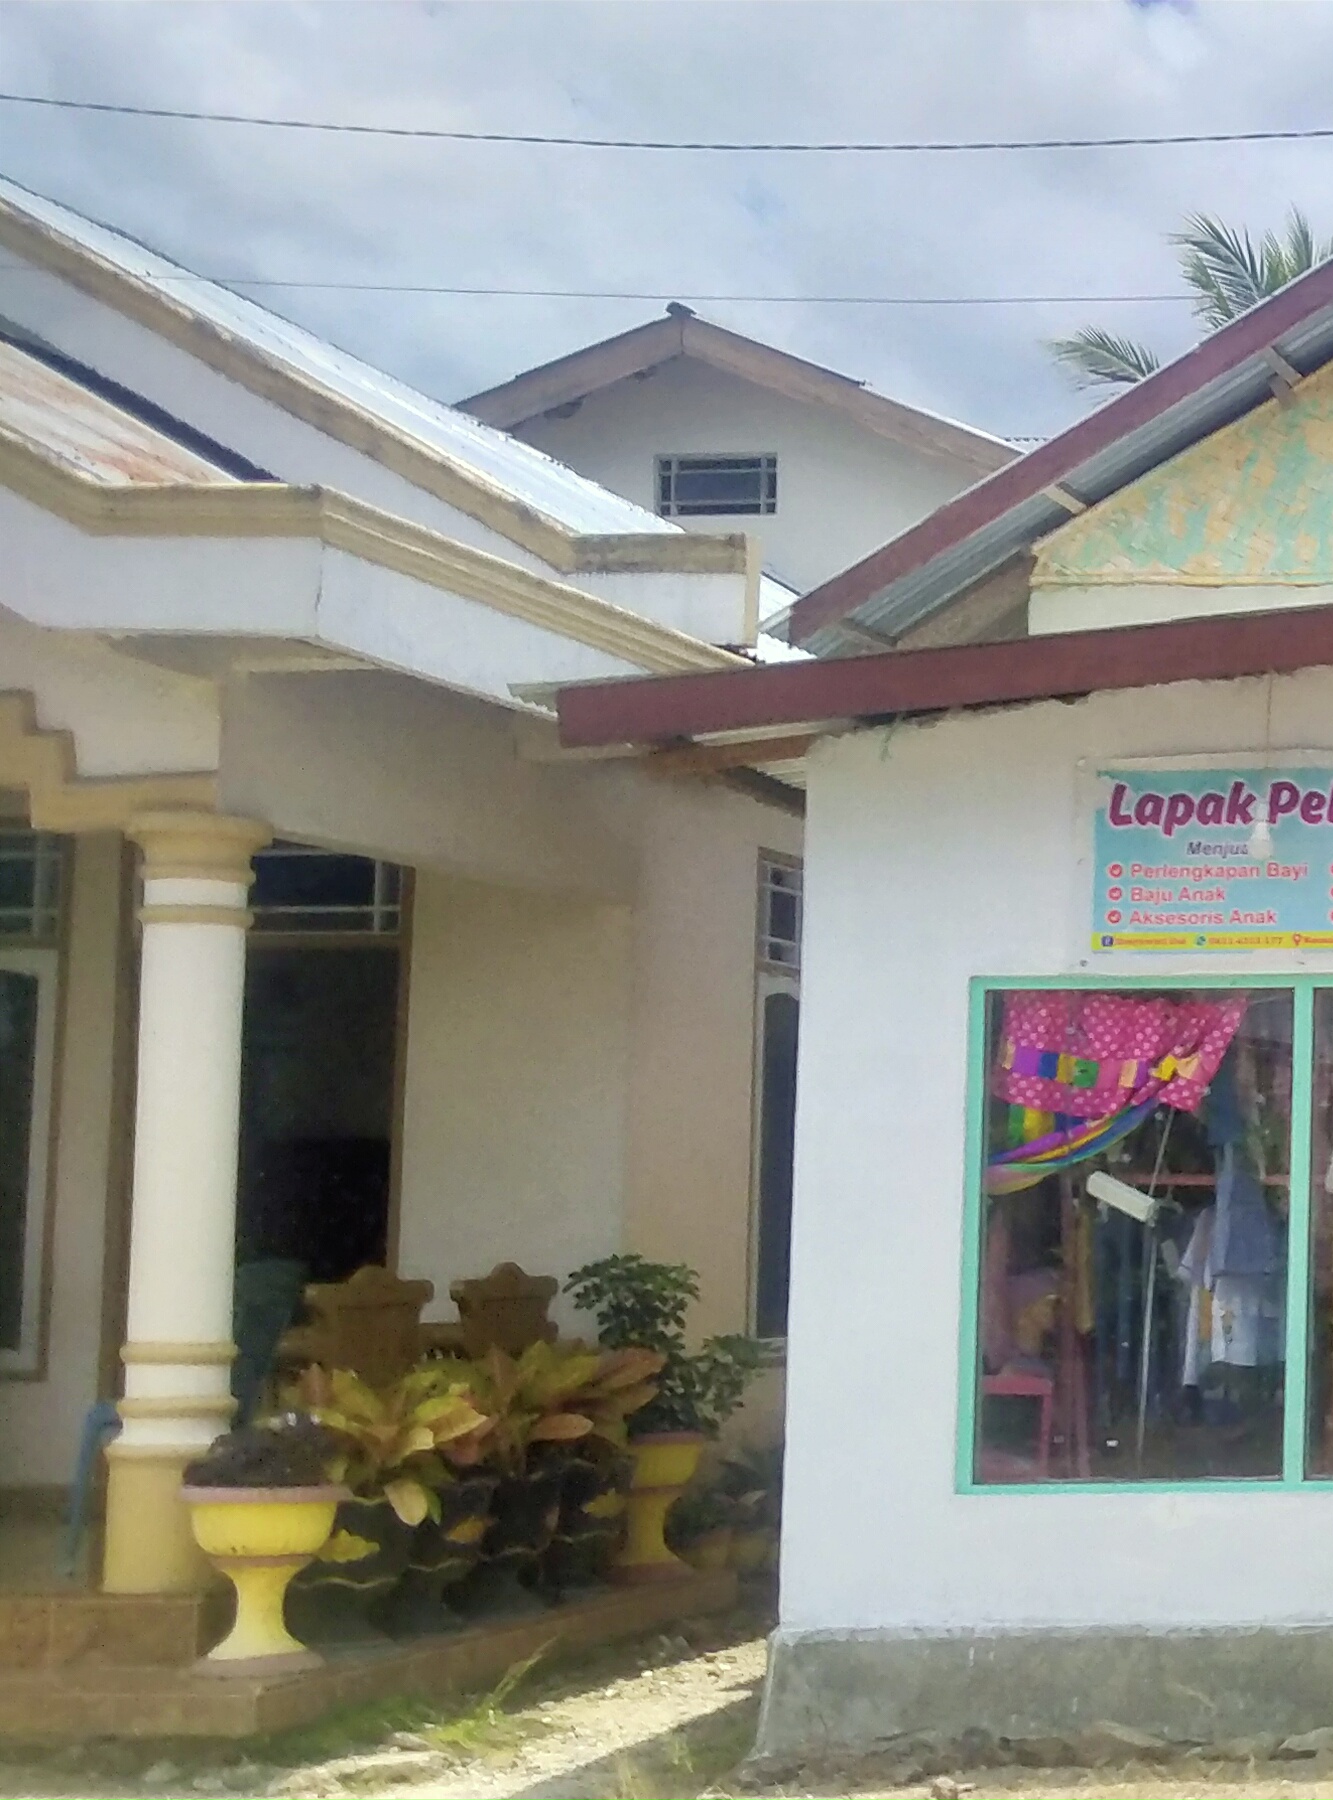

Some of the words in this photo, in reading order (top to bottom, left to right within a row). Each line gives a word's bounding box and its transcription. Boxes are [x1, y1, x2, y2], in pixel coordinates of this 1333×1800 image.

[1109, 780, 1256, 836] Lapak
[1186, 841, 1249, 859] Menjua
[1131, 863, 1260, 882] Perlengkapan
[1266, 862, 1308, 881] Bayi
[1131, 887, 1173, 905] Baju
[1178, 886, 1225, 901] Anak
[1130, 910, 1224, 925] Aksesoris
[1229, 909, 1278, 925] Anak
